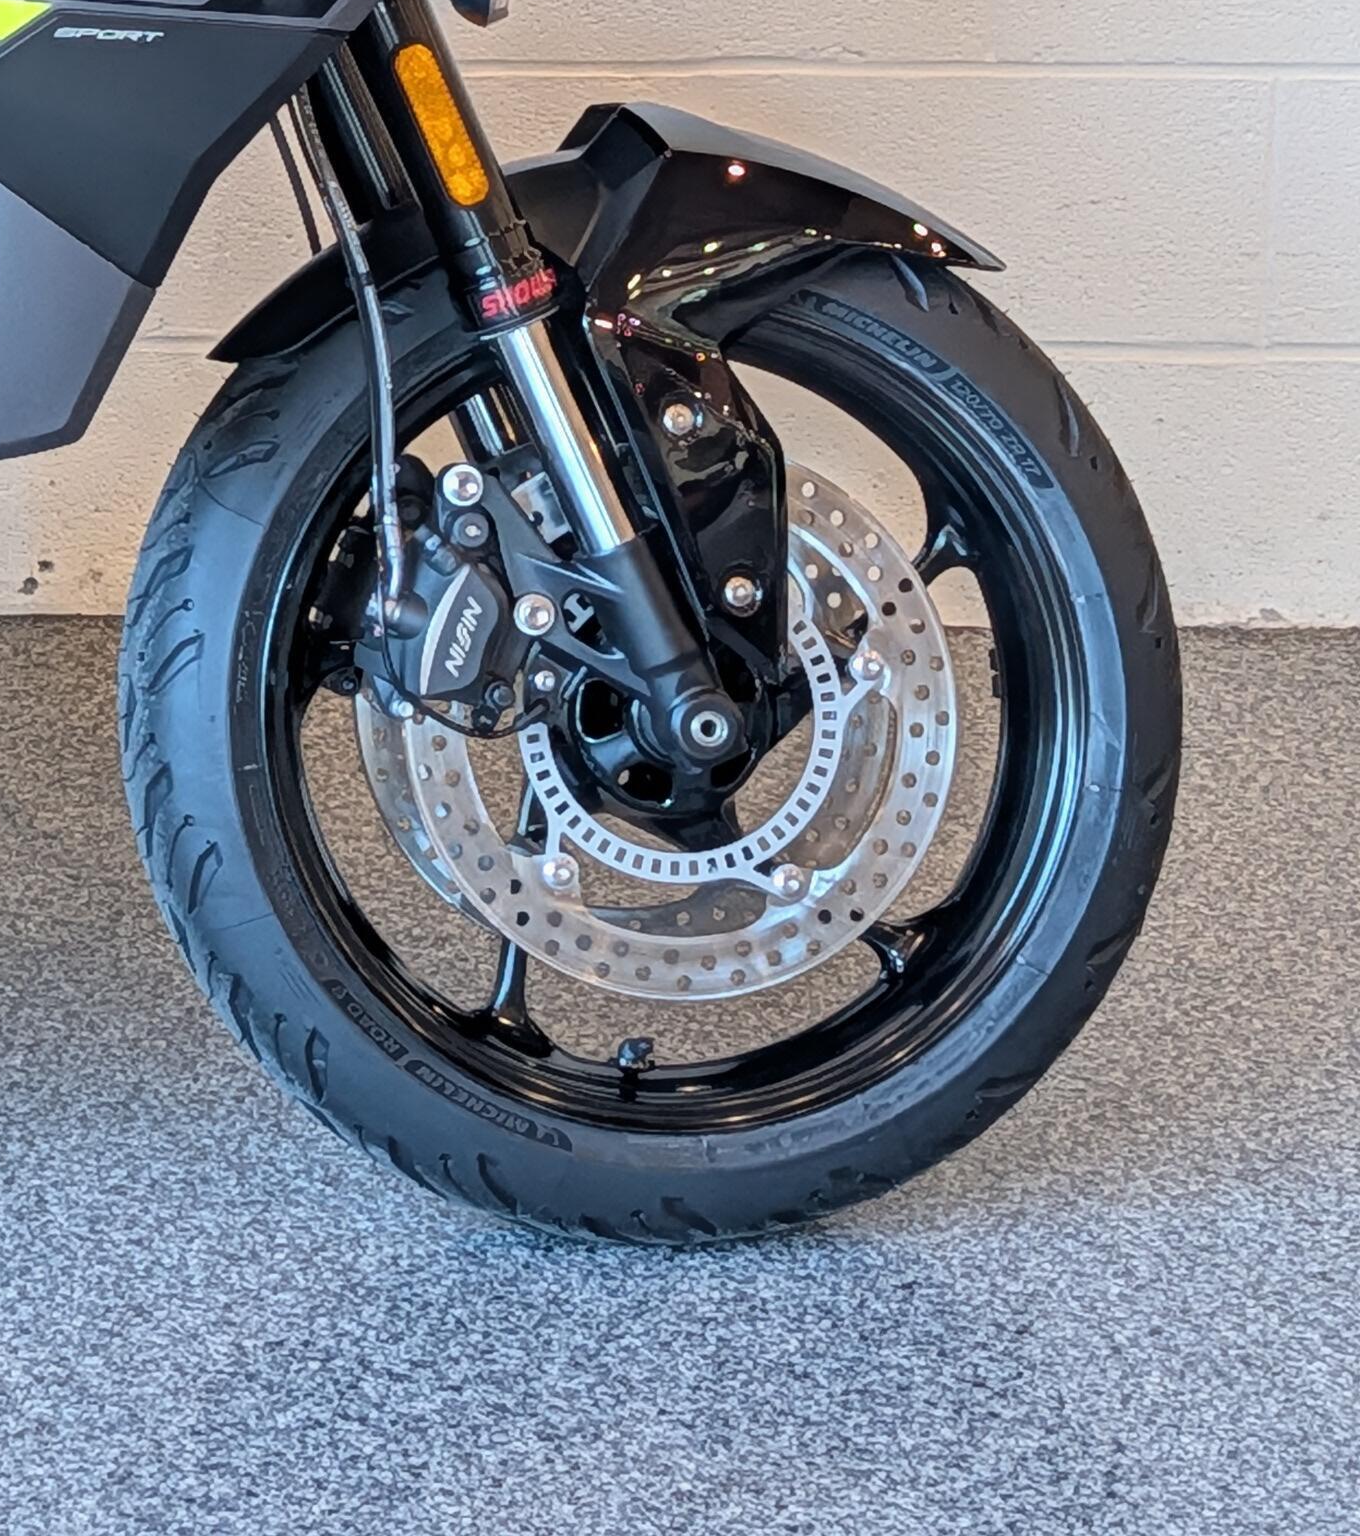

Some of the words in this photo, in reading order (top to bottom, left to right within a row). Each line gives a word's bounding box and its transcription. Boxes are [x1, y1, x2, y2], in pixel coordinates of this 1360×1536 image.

[53, 26, 165, 42] SPORT
[821, 301, 938, 369] MICHELIN
[346, 1001, 402, 1055] ROAD
